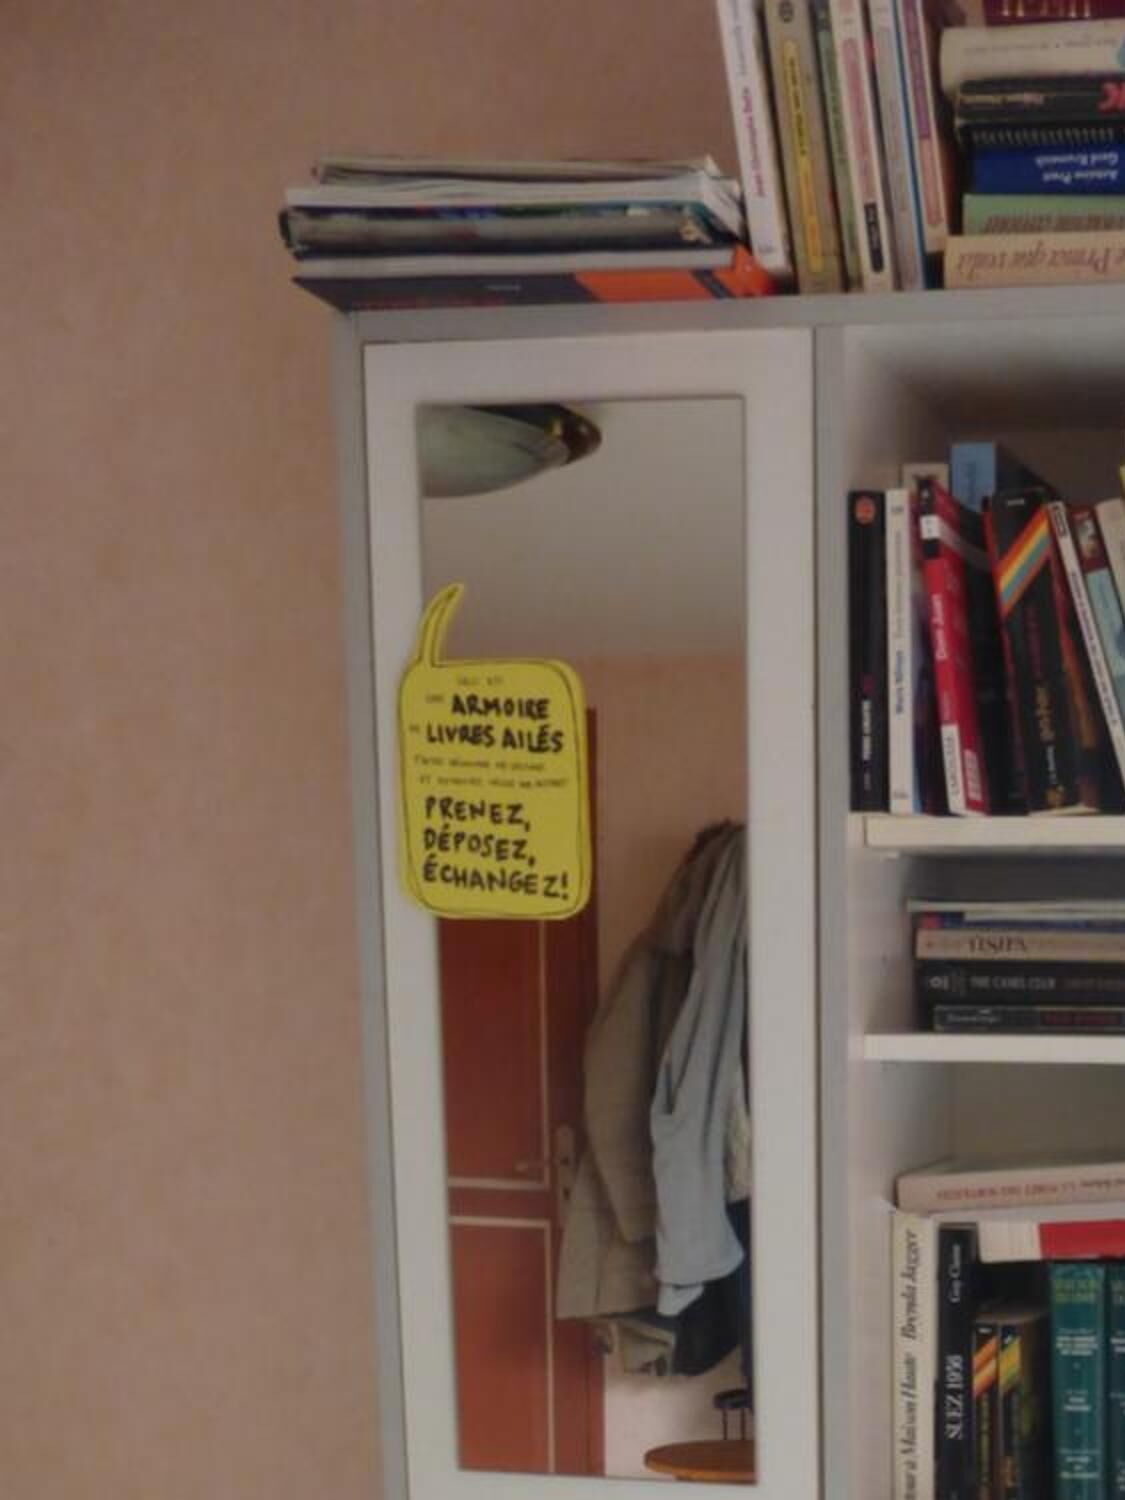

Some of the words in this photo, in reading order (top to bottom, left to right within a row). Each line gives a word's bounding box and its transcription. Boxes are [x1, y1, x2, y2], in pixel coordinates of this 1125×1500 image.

[450, 693, 551, 720] ARMOIRE
[426, 723, 496, 748] LIVRES
[501, 721, 564, 753] AILÉS
[423, 795, 531, 831] PRENEZ,
[422, 823, 536, 867] DÉPOSEZ,
[945, 1393, 965, 1441] SUEZ
